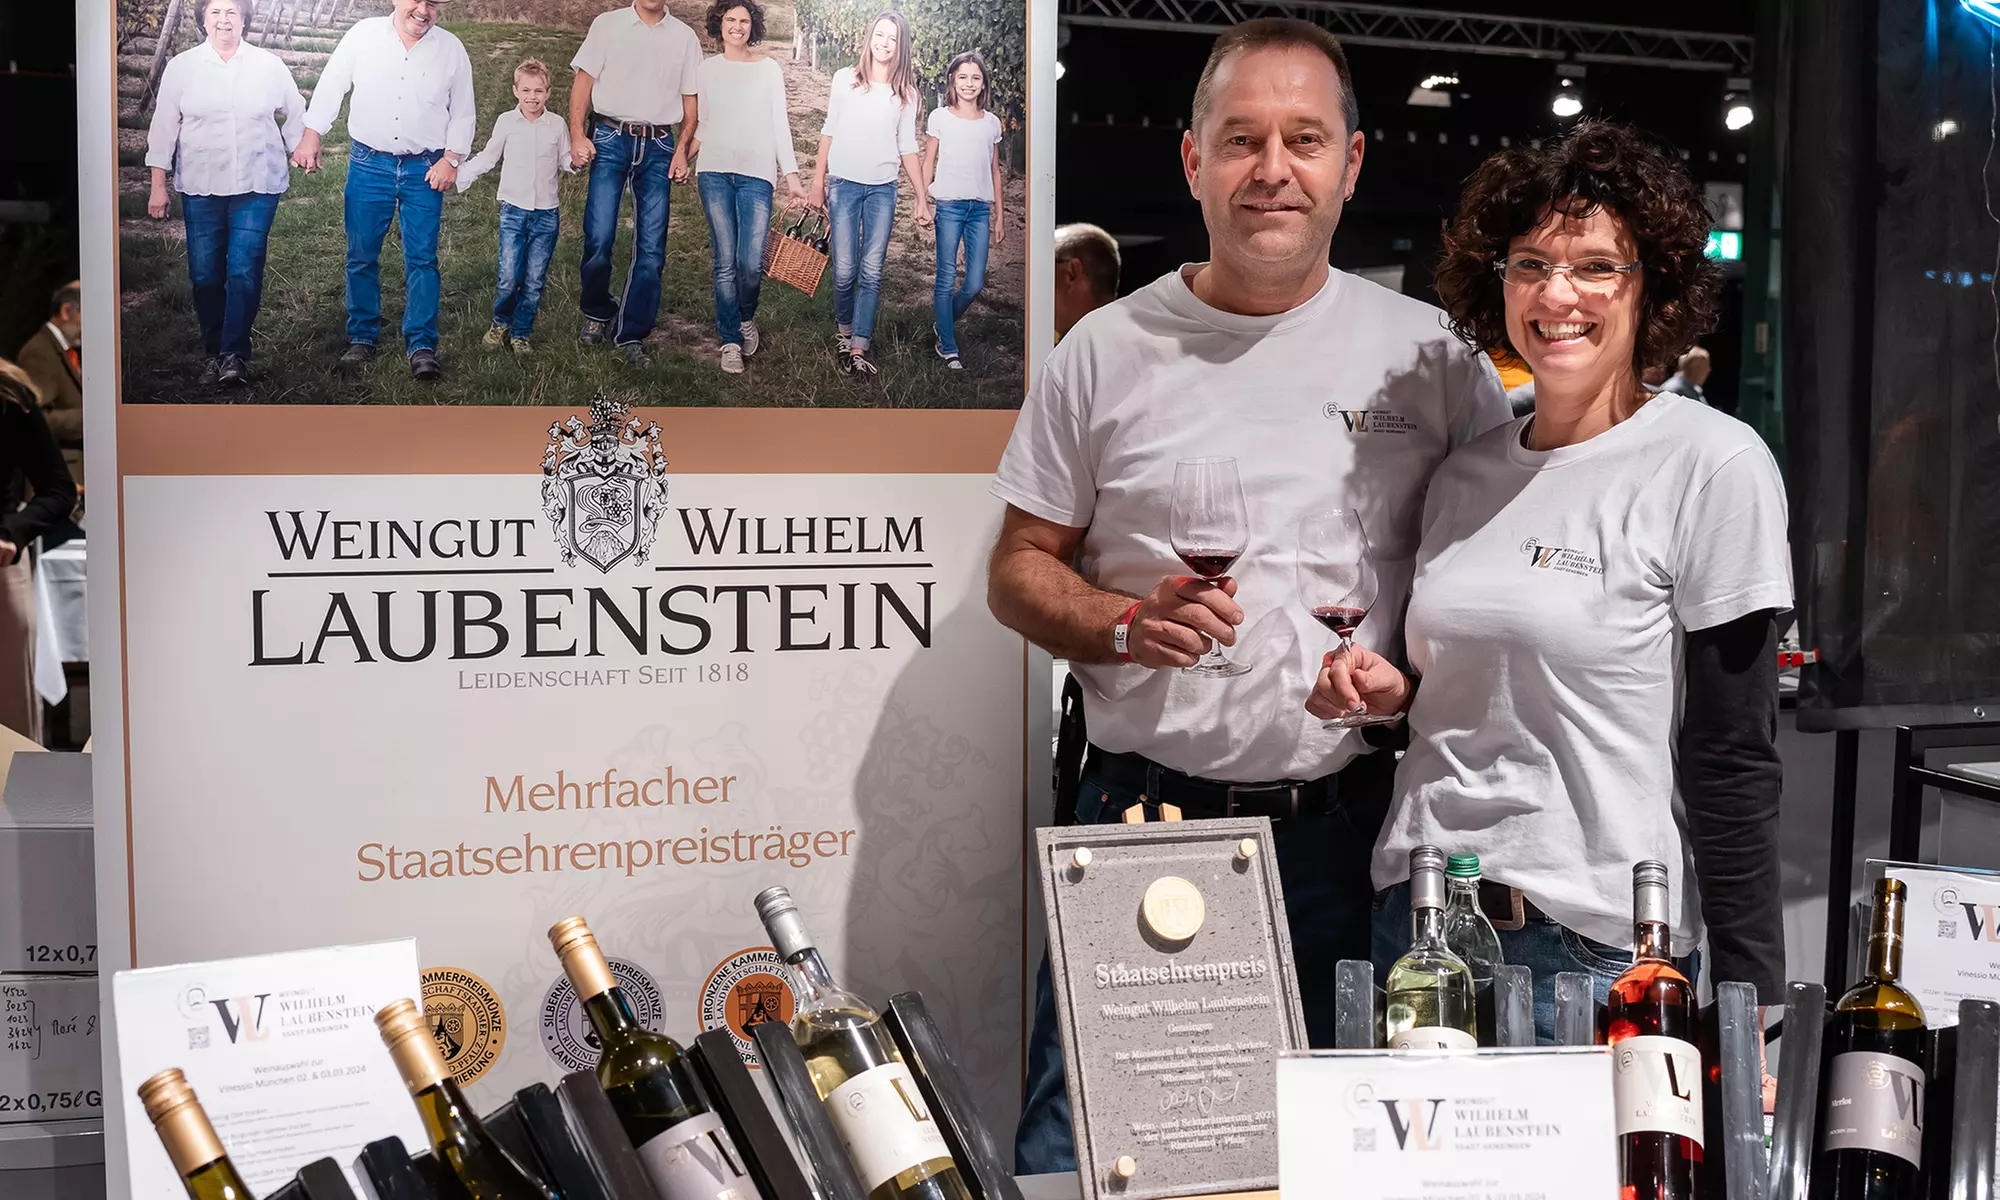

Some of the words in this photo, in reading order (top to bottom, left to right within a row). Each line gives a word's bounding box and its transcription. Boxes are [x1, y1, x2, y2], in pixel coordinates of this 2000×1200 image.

[1373, 422, 1417, 430] LAUBENSTEIN
[265, 510, 536, 561] WEINGUT
[677, 507, 925, 555] WILHELM
[1562, 553, 1595, 565] WILHELM
[248, 581, 936, 666] LAUBENSTEIN
[458, 667, 629, 690] LEIDENSCHAFT
[637, 664, 688, 686] SEIT
[697, 663, 749, 683] 1818
[484, 765, 737, 813] Mehrfacher
[356, 825, 856, 883] Staatsehrenpreisträger
[1096, 955, 1267, 985] Staatsehrenpreis
[1957, 970, 1987, 980] Vinessio
[280, 995, 346, 1012] WILHELM
[544, 978, 569, 1027] SILBERNE
[704, 966, 732, 1020] BRONZENE
[281, 1004, 376, 1027] LAUBENSTEIN
[1101, 1003, 1151, 1018] Weingut
[1152, 999, 1200, 1013] Wilhelm
[1202, 993, 1270, 1009] Laubenstein
[255, 1075, 295, 1089] München
[312, 1071, 319, 1080] &
[1255, 1110, 1277, 1120] 2021
[1455, 1108, 1529, 1121] WILHELM
[1455, 1123, 1561, 1138] LAUBENSTEIN
